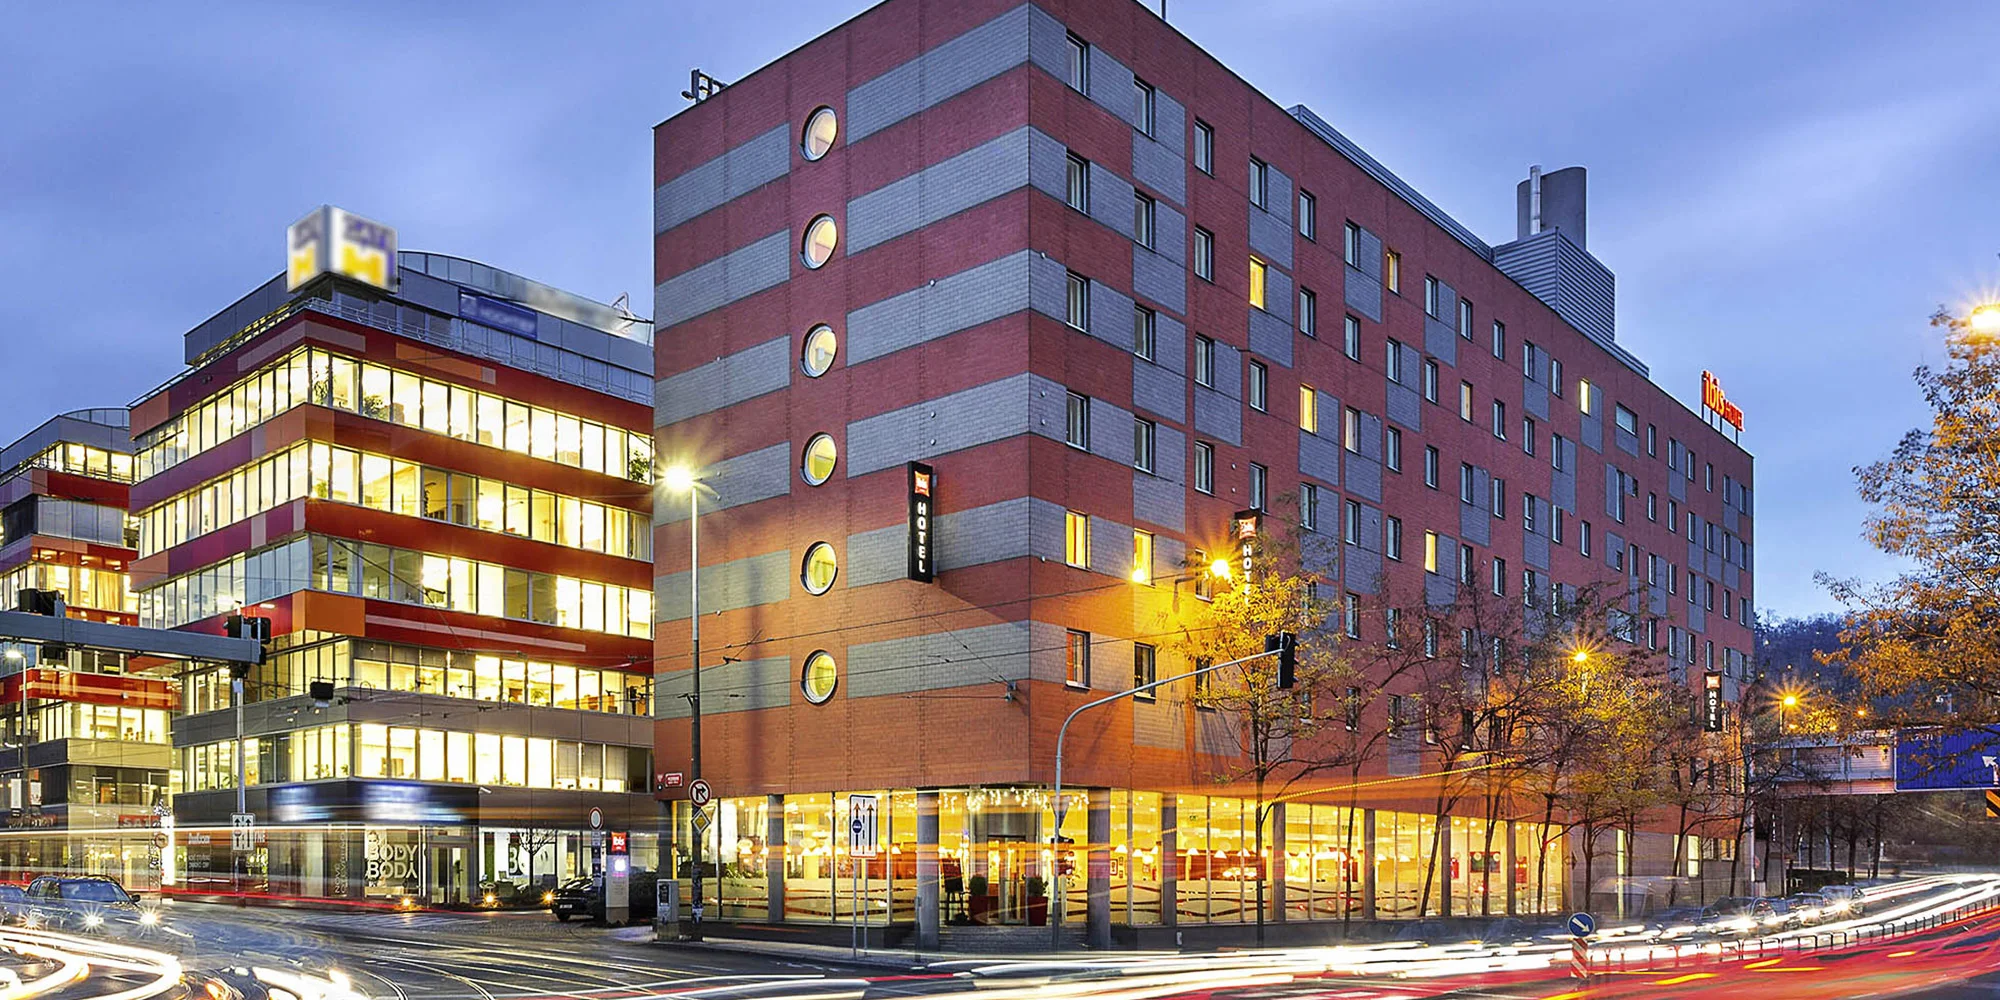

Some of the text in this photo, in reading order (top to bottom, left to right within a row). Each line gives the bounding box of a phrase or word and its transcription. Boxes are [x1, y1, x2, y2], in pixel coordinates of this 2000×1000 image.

[1703, 370, 1725, 416] ibis
[917, 501, 927, 573] HOTEL
[1709, 691, 1717, 728] HOTEL
[368, 843, 418, 861] BODY
